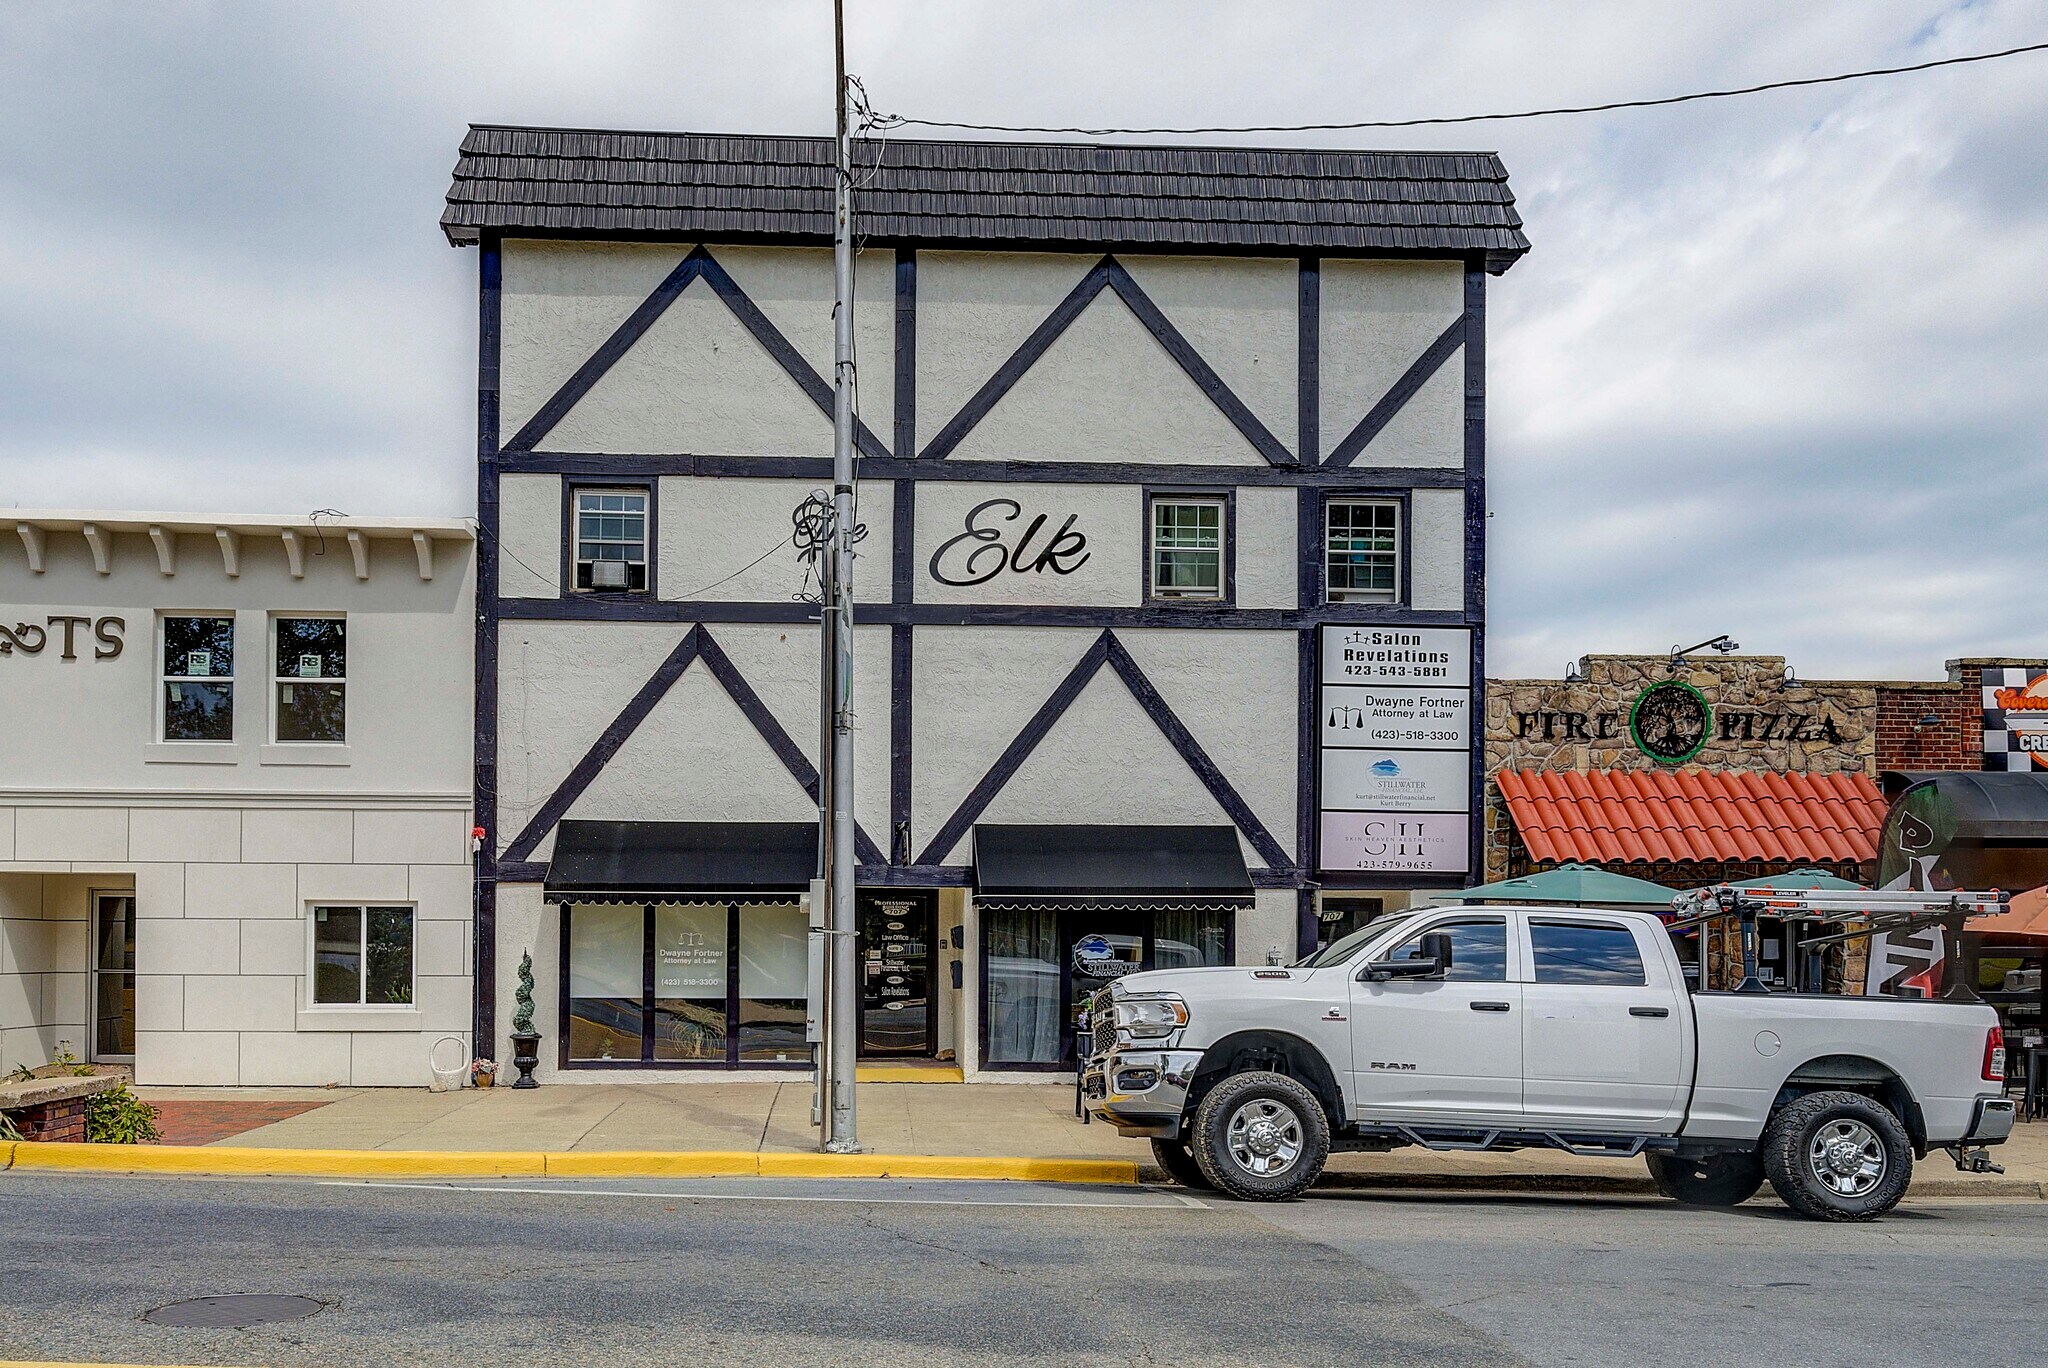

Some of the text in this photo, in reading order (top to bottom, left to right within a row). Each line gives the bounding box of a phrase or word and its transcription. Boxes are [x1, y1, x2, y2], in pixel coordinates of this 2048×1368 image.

[929, 498, 1091, 587] Elk
[1372, 632, 1421, 646] Salon
[1344, 648, 1449, 663] Revelations
[1344, 665, 1447, 677] 423-543-5881
[1365, 695, 1465, 709] Dwayne Fortner
[1372, 708, 1453, 719] Attorney at Law
[1516, 711, 1844, 745] FIRE PIZZA
[1371, 728, 1459, 741] (423)-518-3300
[1378, 781, 1426, 789] STILLWATER
[1356, 860, 1433, 870] 423-579-9655
[1324, 912, 1341, 921] 707
[660, 949, 723, 958] Dwayne Fortner
[663, 957, 692, 965] Attorney
[1088, 962, 1141, 971] STILLWATER
[661, 978, 718, 987] (423) 518-3300
[1370, 1061, 1417, 1071] RAM
[1865, 1187, 1894, 1208] POWER
